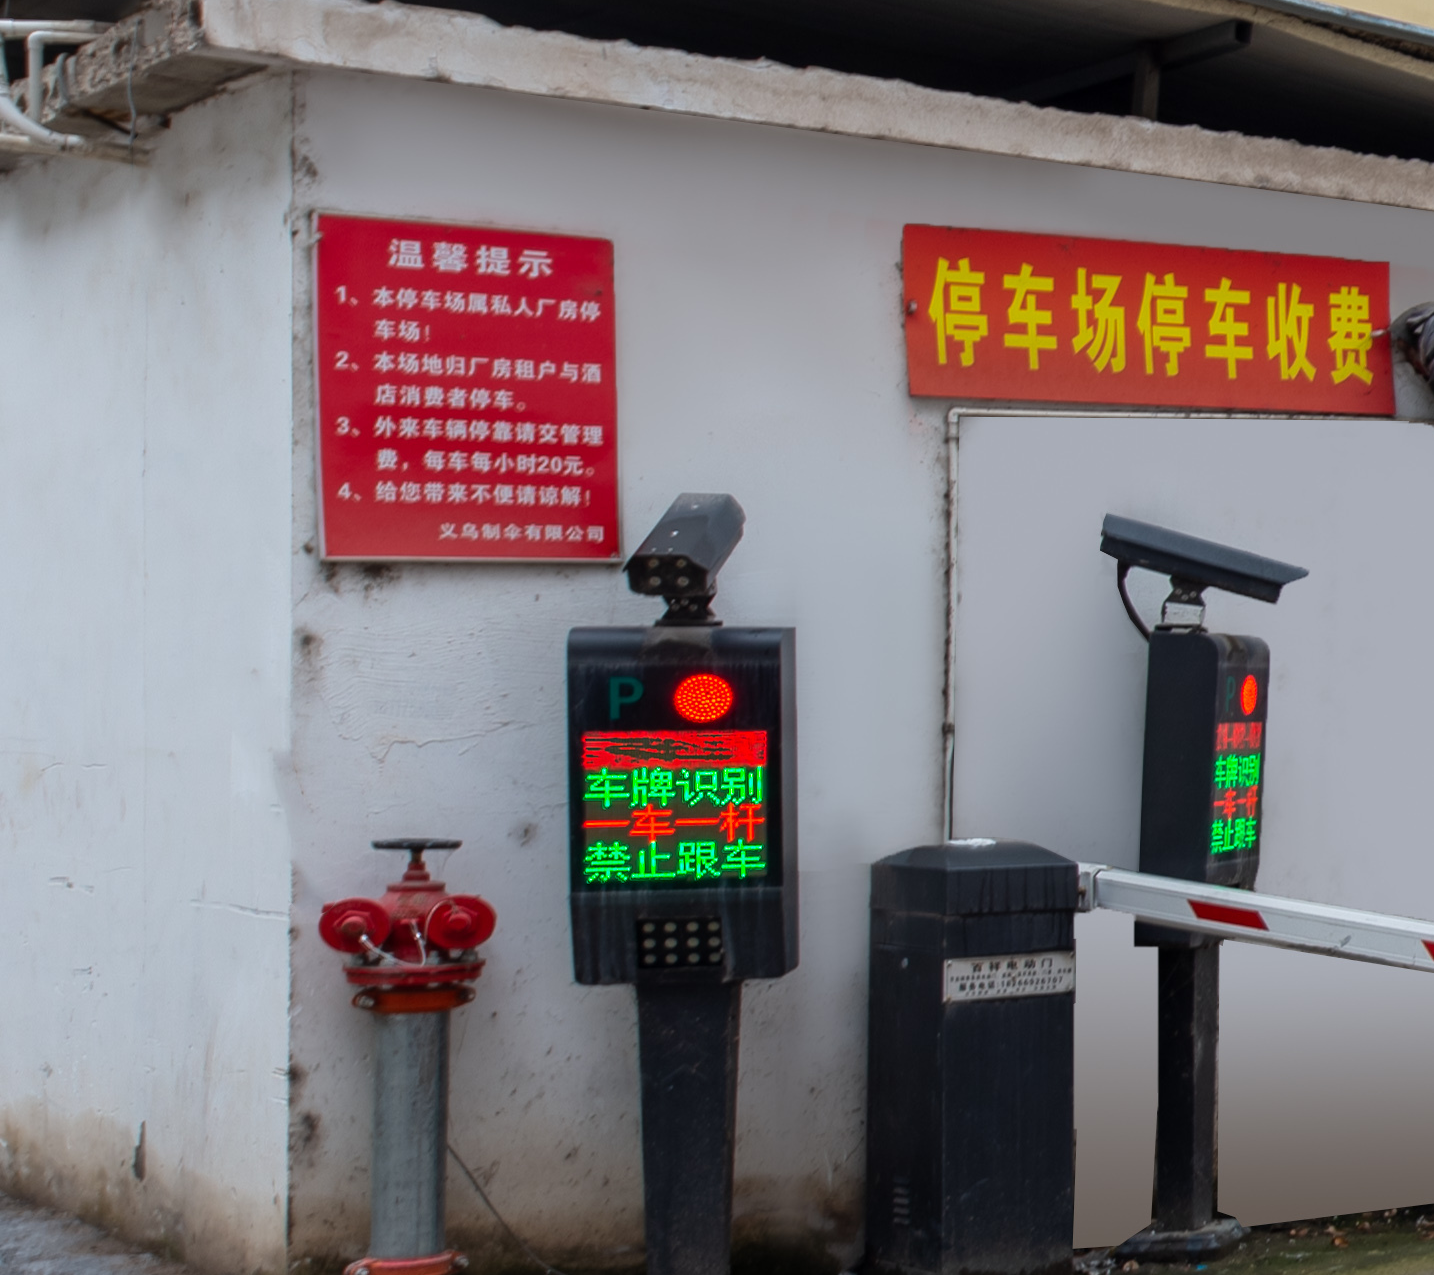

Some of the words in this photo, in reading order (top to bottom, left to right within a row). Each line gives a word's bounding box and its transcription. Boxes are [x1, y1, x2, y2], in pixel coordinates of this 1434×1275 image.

[387, 237, 553, 278] 温馨提示
[928, 257, 1374, 386] 停车场停车收费
[608, 677, 645, 720] P
[1226, 676, 1237, 712] P
[583, 766, 763, 809] 车牌识别
[1214, 753, 1261, 789] 车牌识别
[582, 802, 766, 843] 一车一杆
[1210, 815, 1257, 855] 禁止跟车
[584, 838, 766, 884] 禁止跟车
